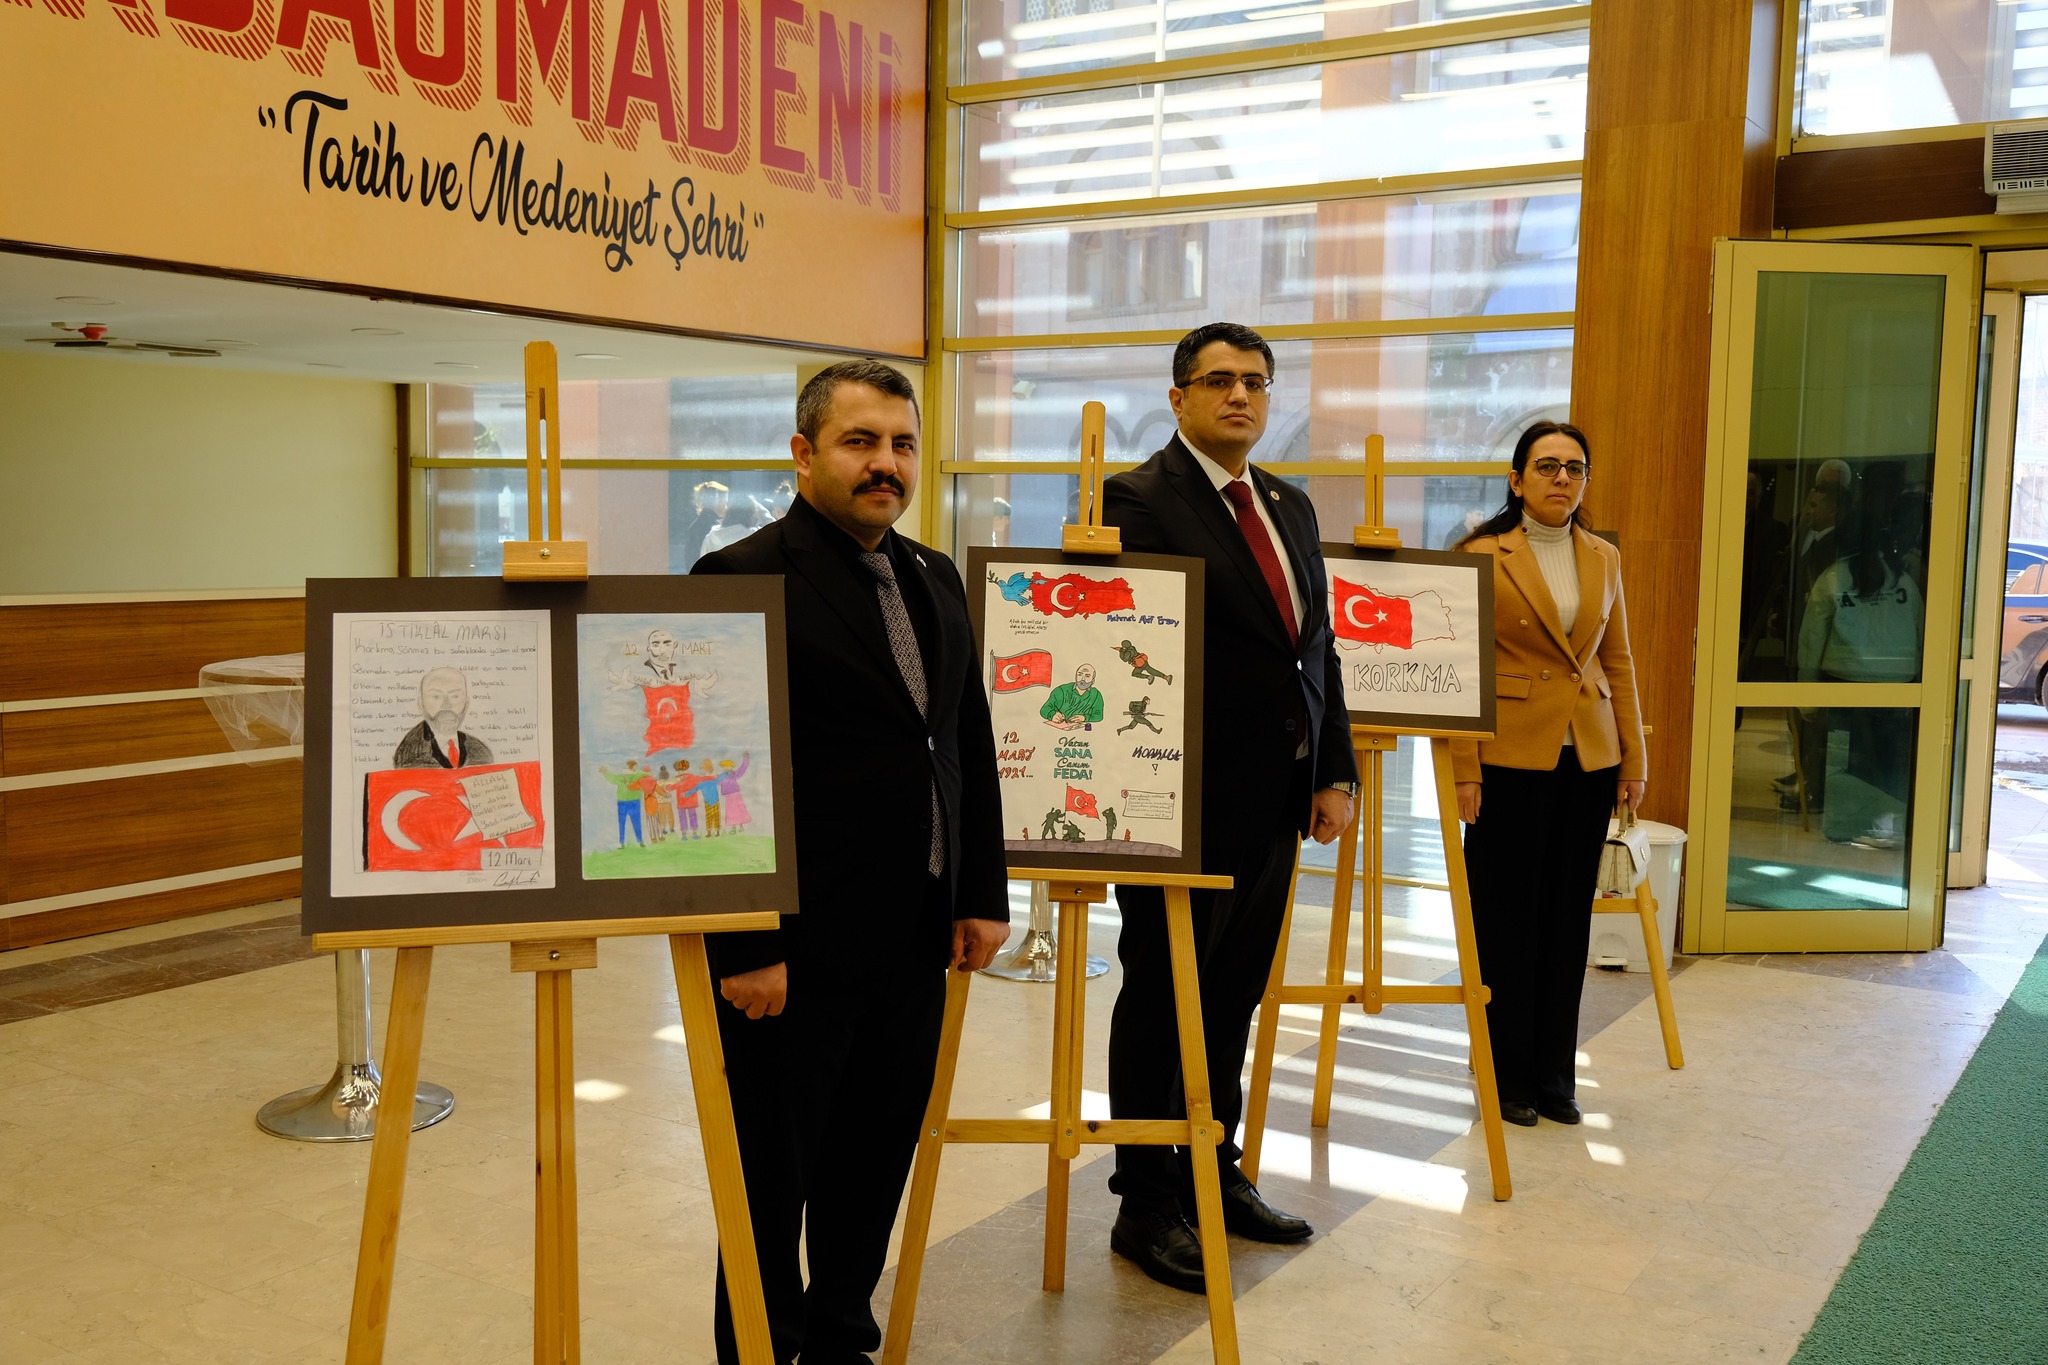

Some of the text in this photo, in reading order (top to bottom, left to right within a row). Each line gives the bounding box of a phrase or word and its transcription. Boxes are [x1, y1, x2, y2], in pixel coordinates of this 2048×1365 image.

[421, 156, 463, 211] ve
[469, 132, 661, 272] Medeniyet
[434, 645, 446, 655] bu
[625, 641, 713, 655] 12 MART
[1353, 662, 1462, 693] KORKMA
[1003, 731, 1020, 744] 12
[1058, 736, 1090, 747] Vatan
[1053, 747, 1093, 759] SANA
[1053, 768, 1093, 780] FEDA!
[488, 850, 532, 867] 12 Mart
